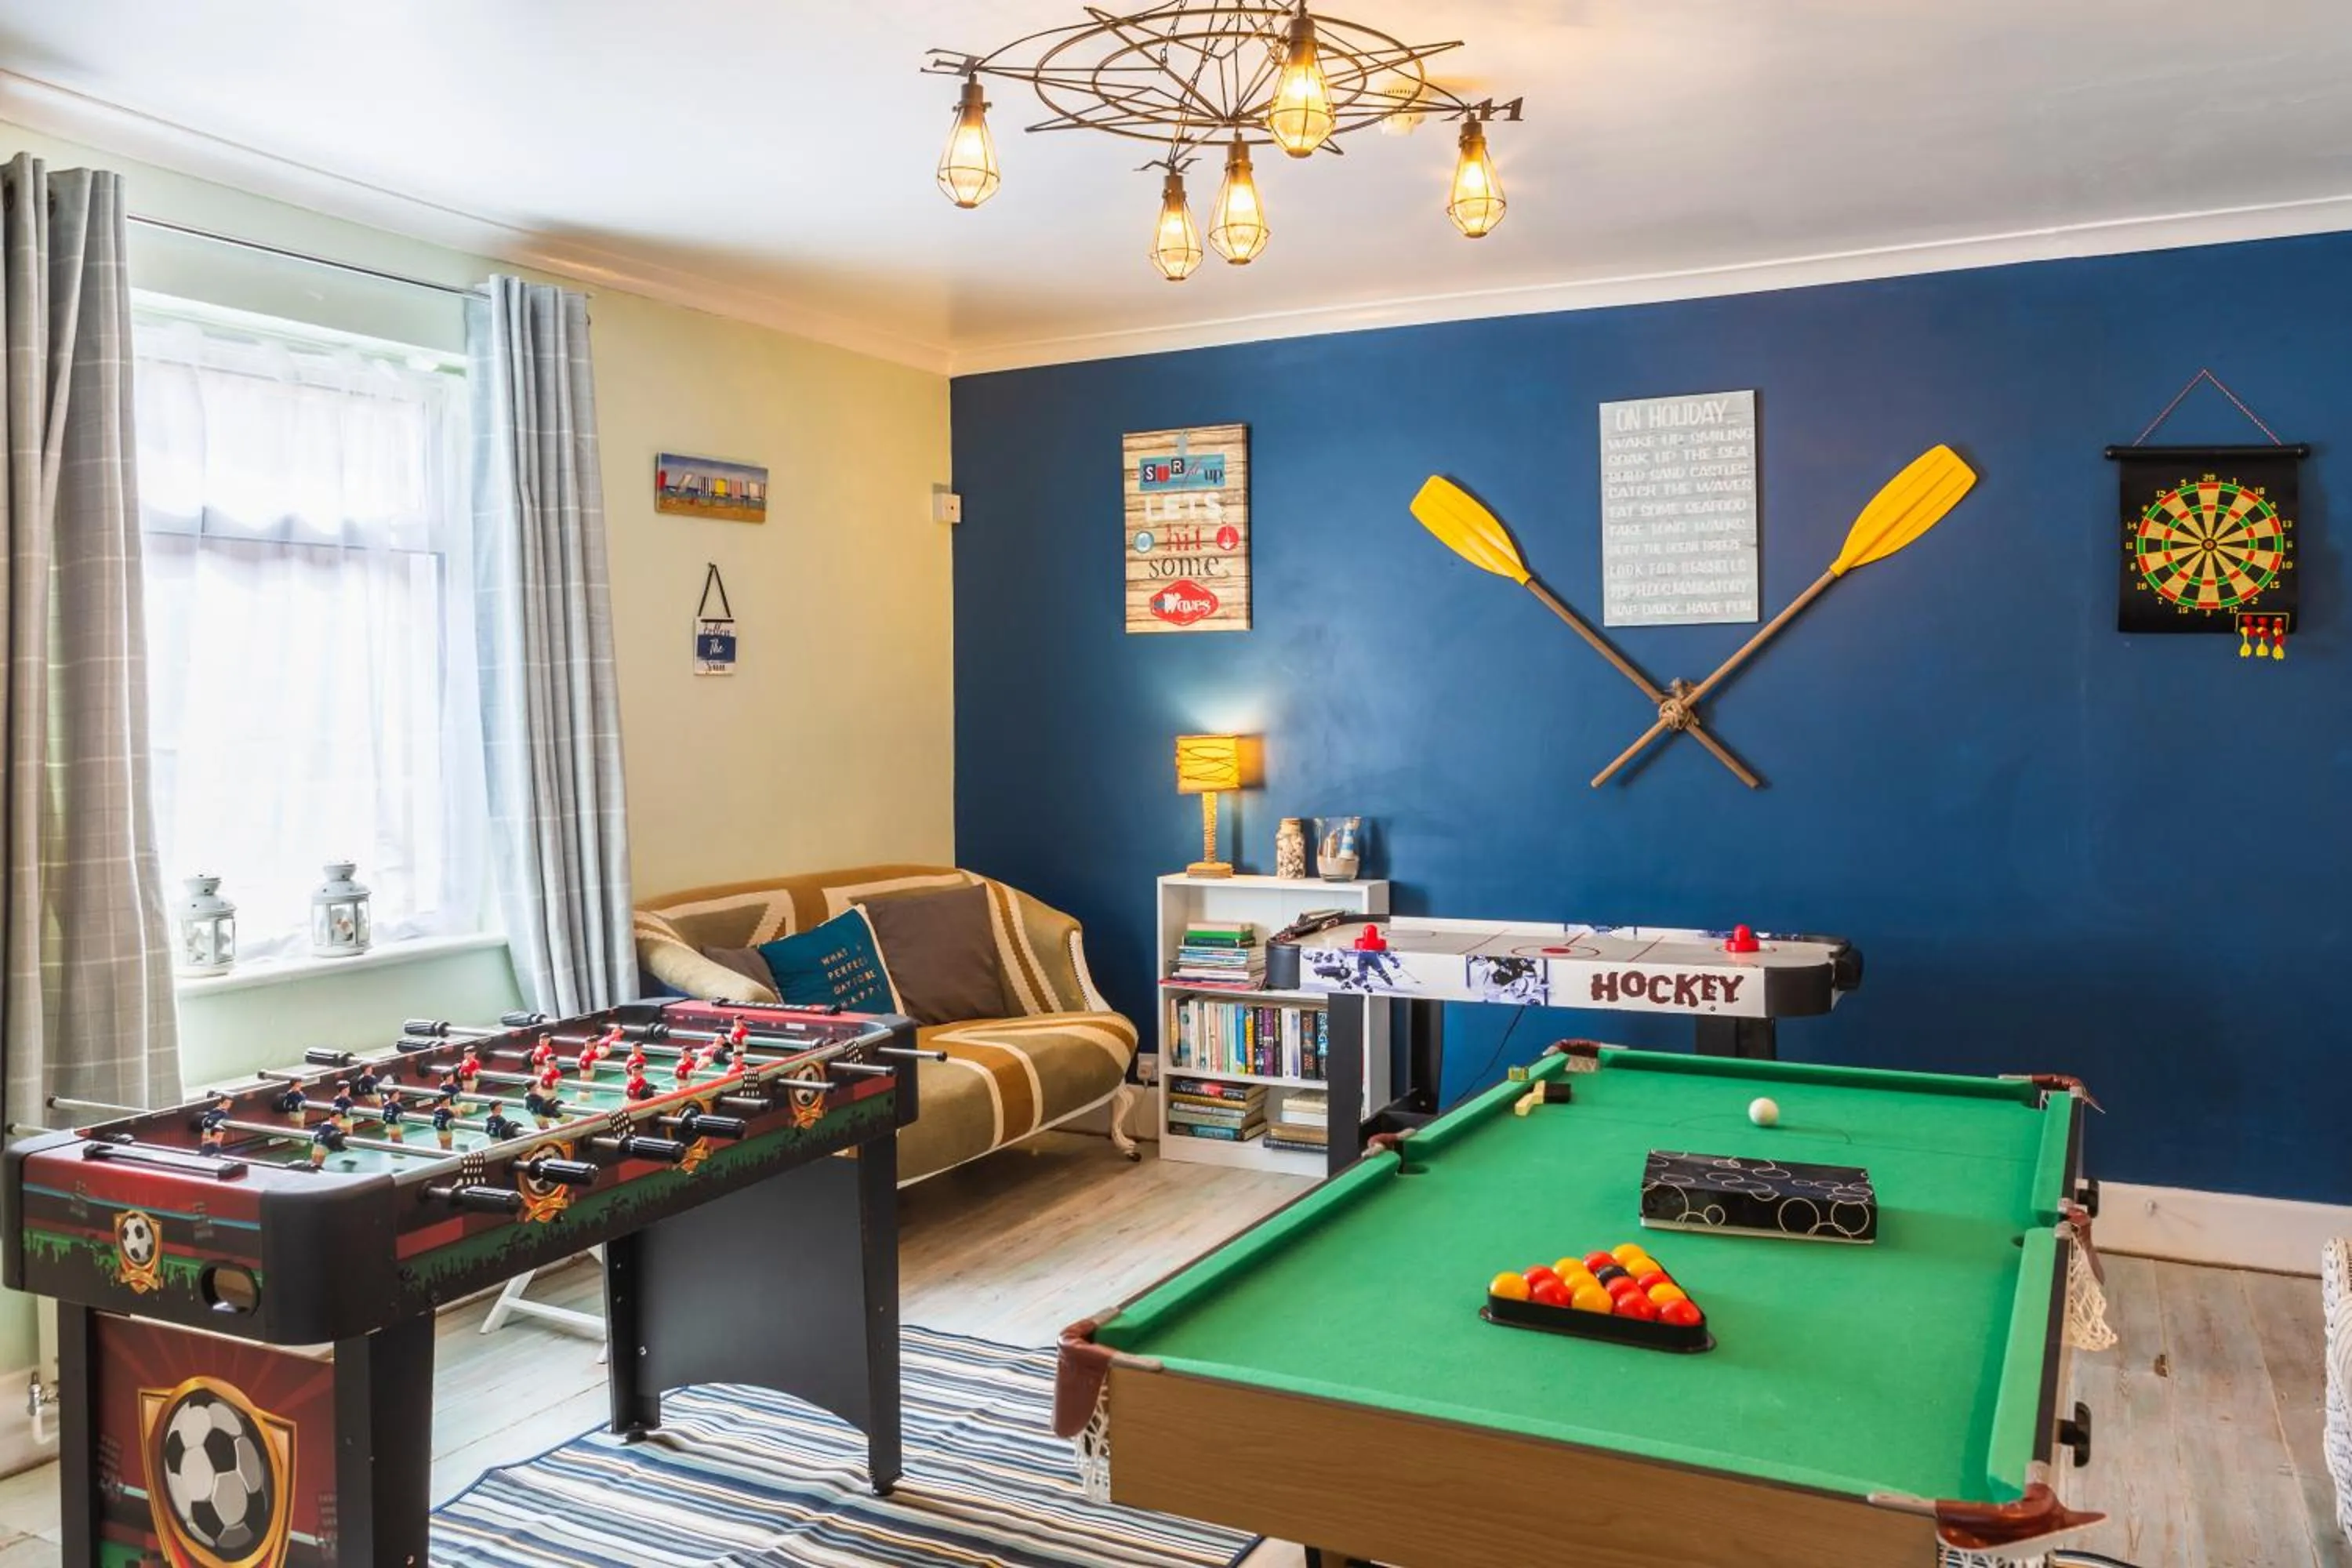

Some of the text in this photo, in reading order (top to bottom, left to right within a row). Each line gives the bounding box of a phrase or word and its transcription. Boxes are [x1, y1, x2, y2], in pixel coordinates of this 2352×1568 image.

[1616, 405, 1640, 430] ON
[1606, 428, 1753, 449] WAKE UP SMILING
[1607, 445, 1748, 465] SOAK UP THE SEA
[1607, 464, 1751, 482] BUILD SAND CASTLES
[1607, 480, 1751, 497] CATCH THE WAVES
[1145, 492, 1222, 522] LETS
[1606, 499, 1746, 517] EAT SOME SEAFOOD
[1607, 518, 1746, 536] TAKE LONG WALKS
[1166, 524, 1202, 551] hit
[1149, 556, 1221, 578] some
[1609, 564, 1643, 577] LOOK
[1649, 562, 1679, 575] FOR
[1609, 600, 1751, 615] NAP DAILY HAVE FUN
[710, 638, 724, 655] The
[820, 947, 848, 966] WHAT
[1314, 952, 1334, 964] 24
[828, 956, 868, 979] PERFECT
[834, 981, 851, 995] DAY
[864, 969, 877, 978] BE
[1590, 970, 1744, 1008] HOCKEY
